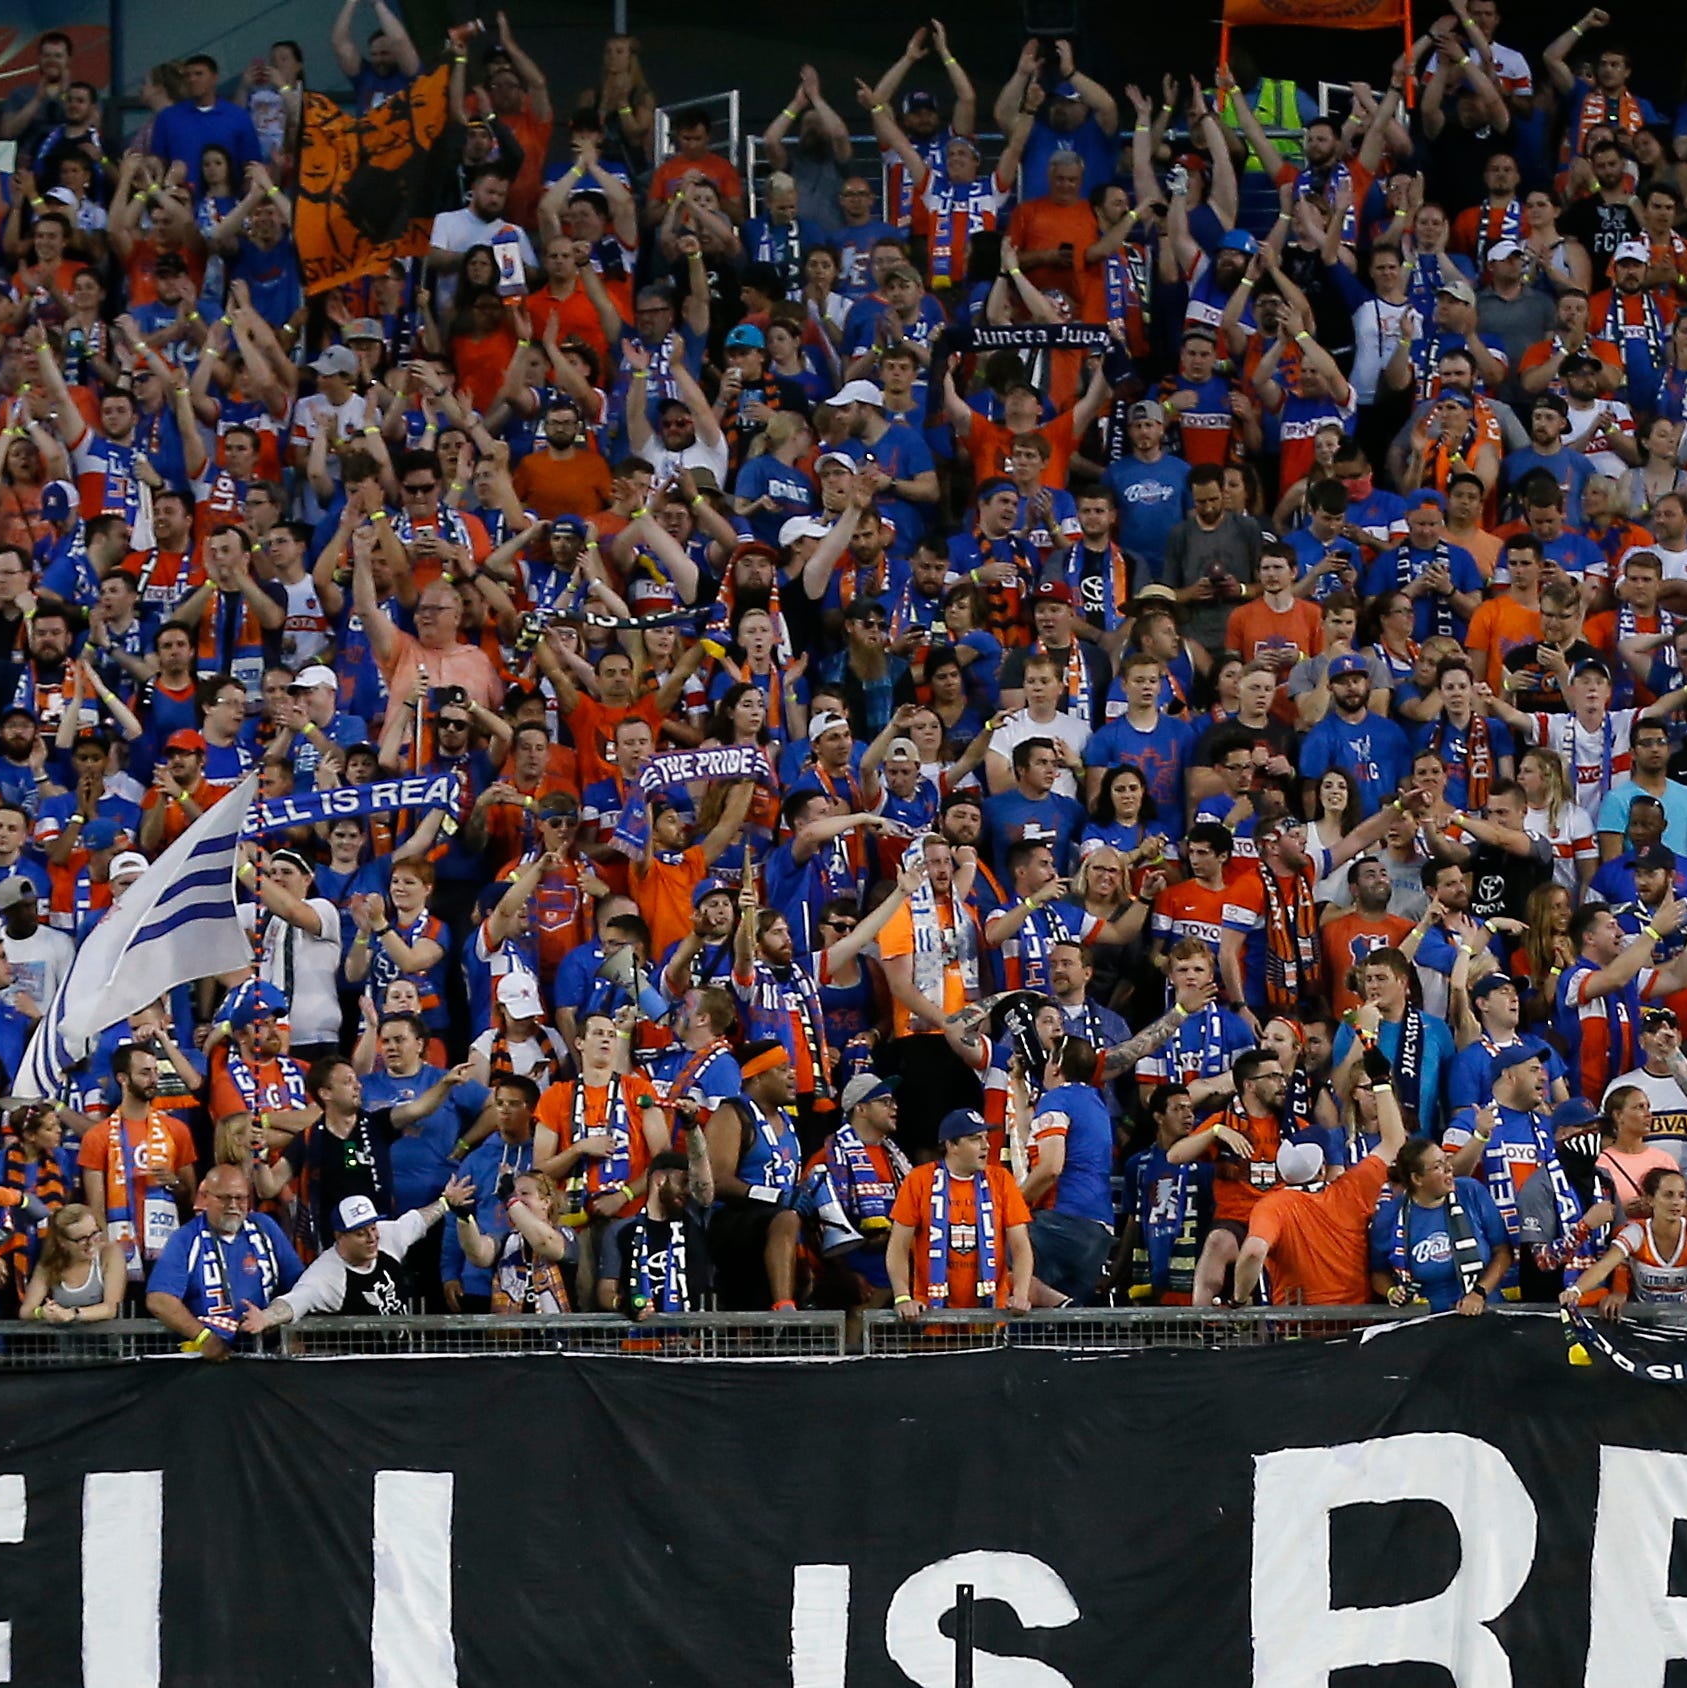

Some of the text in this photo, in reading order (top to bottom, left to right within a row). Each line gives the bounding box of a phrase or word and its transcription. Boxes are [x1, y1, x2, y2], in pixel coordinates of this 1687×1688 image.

[654, 746, 755, 783] THE PRIDE
[243, 798, 312, 836] ELL
[320, 787, 359, 815] IS
[1182, 922, 1221, 940] TOYO
